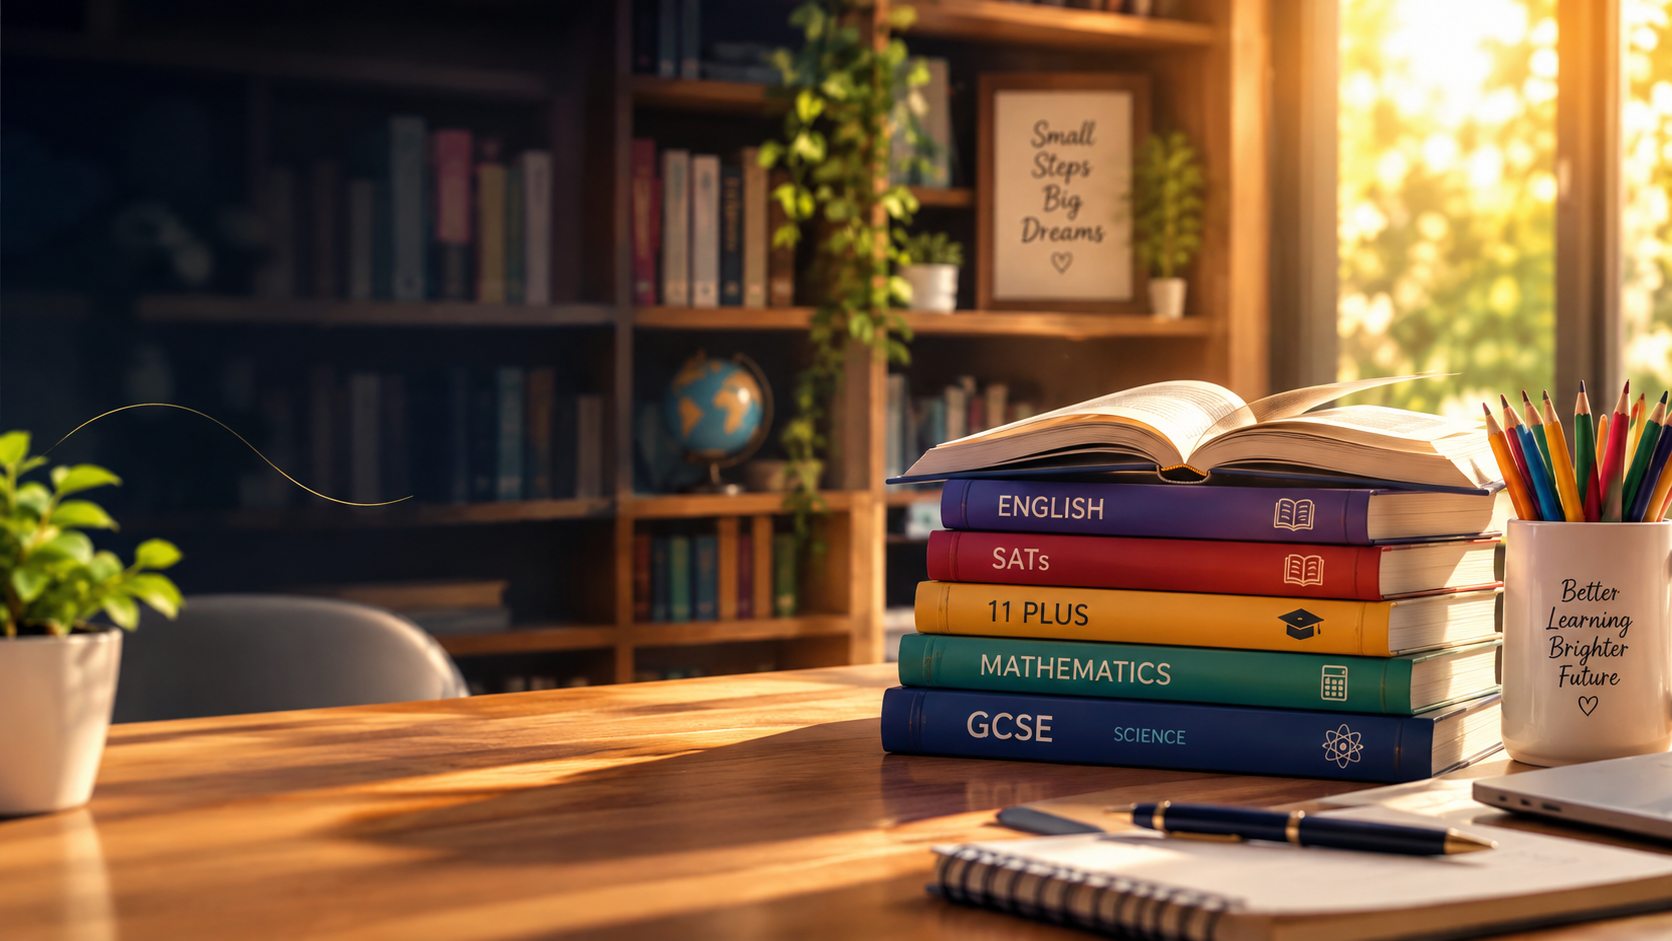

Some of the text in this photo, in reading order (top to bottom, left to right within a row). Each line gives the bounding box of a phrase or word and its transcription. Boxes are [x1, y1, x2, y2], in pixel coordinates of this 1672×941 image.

[1030, 119, 1097, 148] Small
[1031, 151, 1092, 184] Steps
[1042, 184, 1083, 220] Big
[1020, 216, 1106, 243] Dreams
[997, 494, 1105, 520] ENGLISH
[991, 546, 1050, 571] SATs
[1561, 578, 1621, 603] Better
[987, 599, 1089, 627] 11 PLUS
[1546, 606, 1633, 638] Learning
[1548, 635, 1630, 666] Brighter
[980, 653, 1172, 686] MATHEMATICS
[1559, 665, 1620, 688] Future
[966, 710, 1187, 745] GCSE SCIENCE
